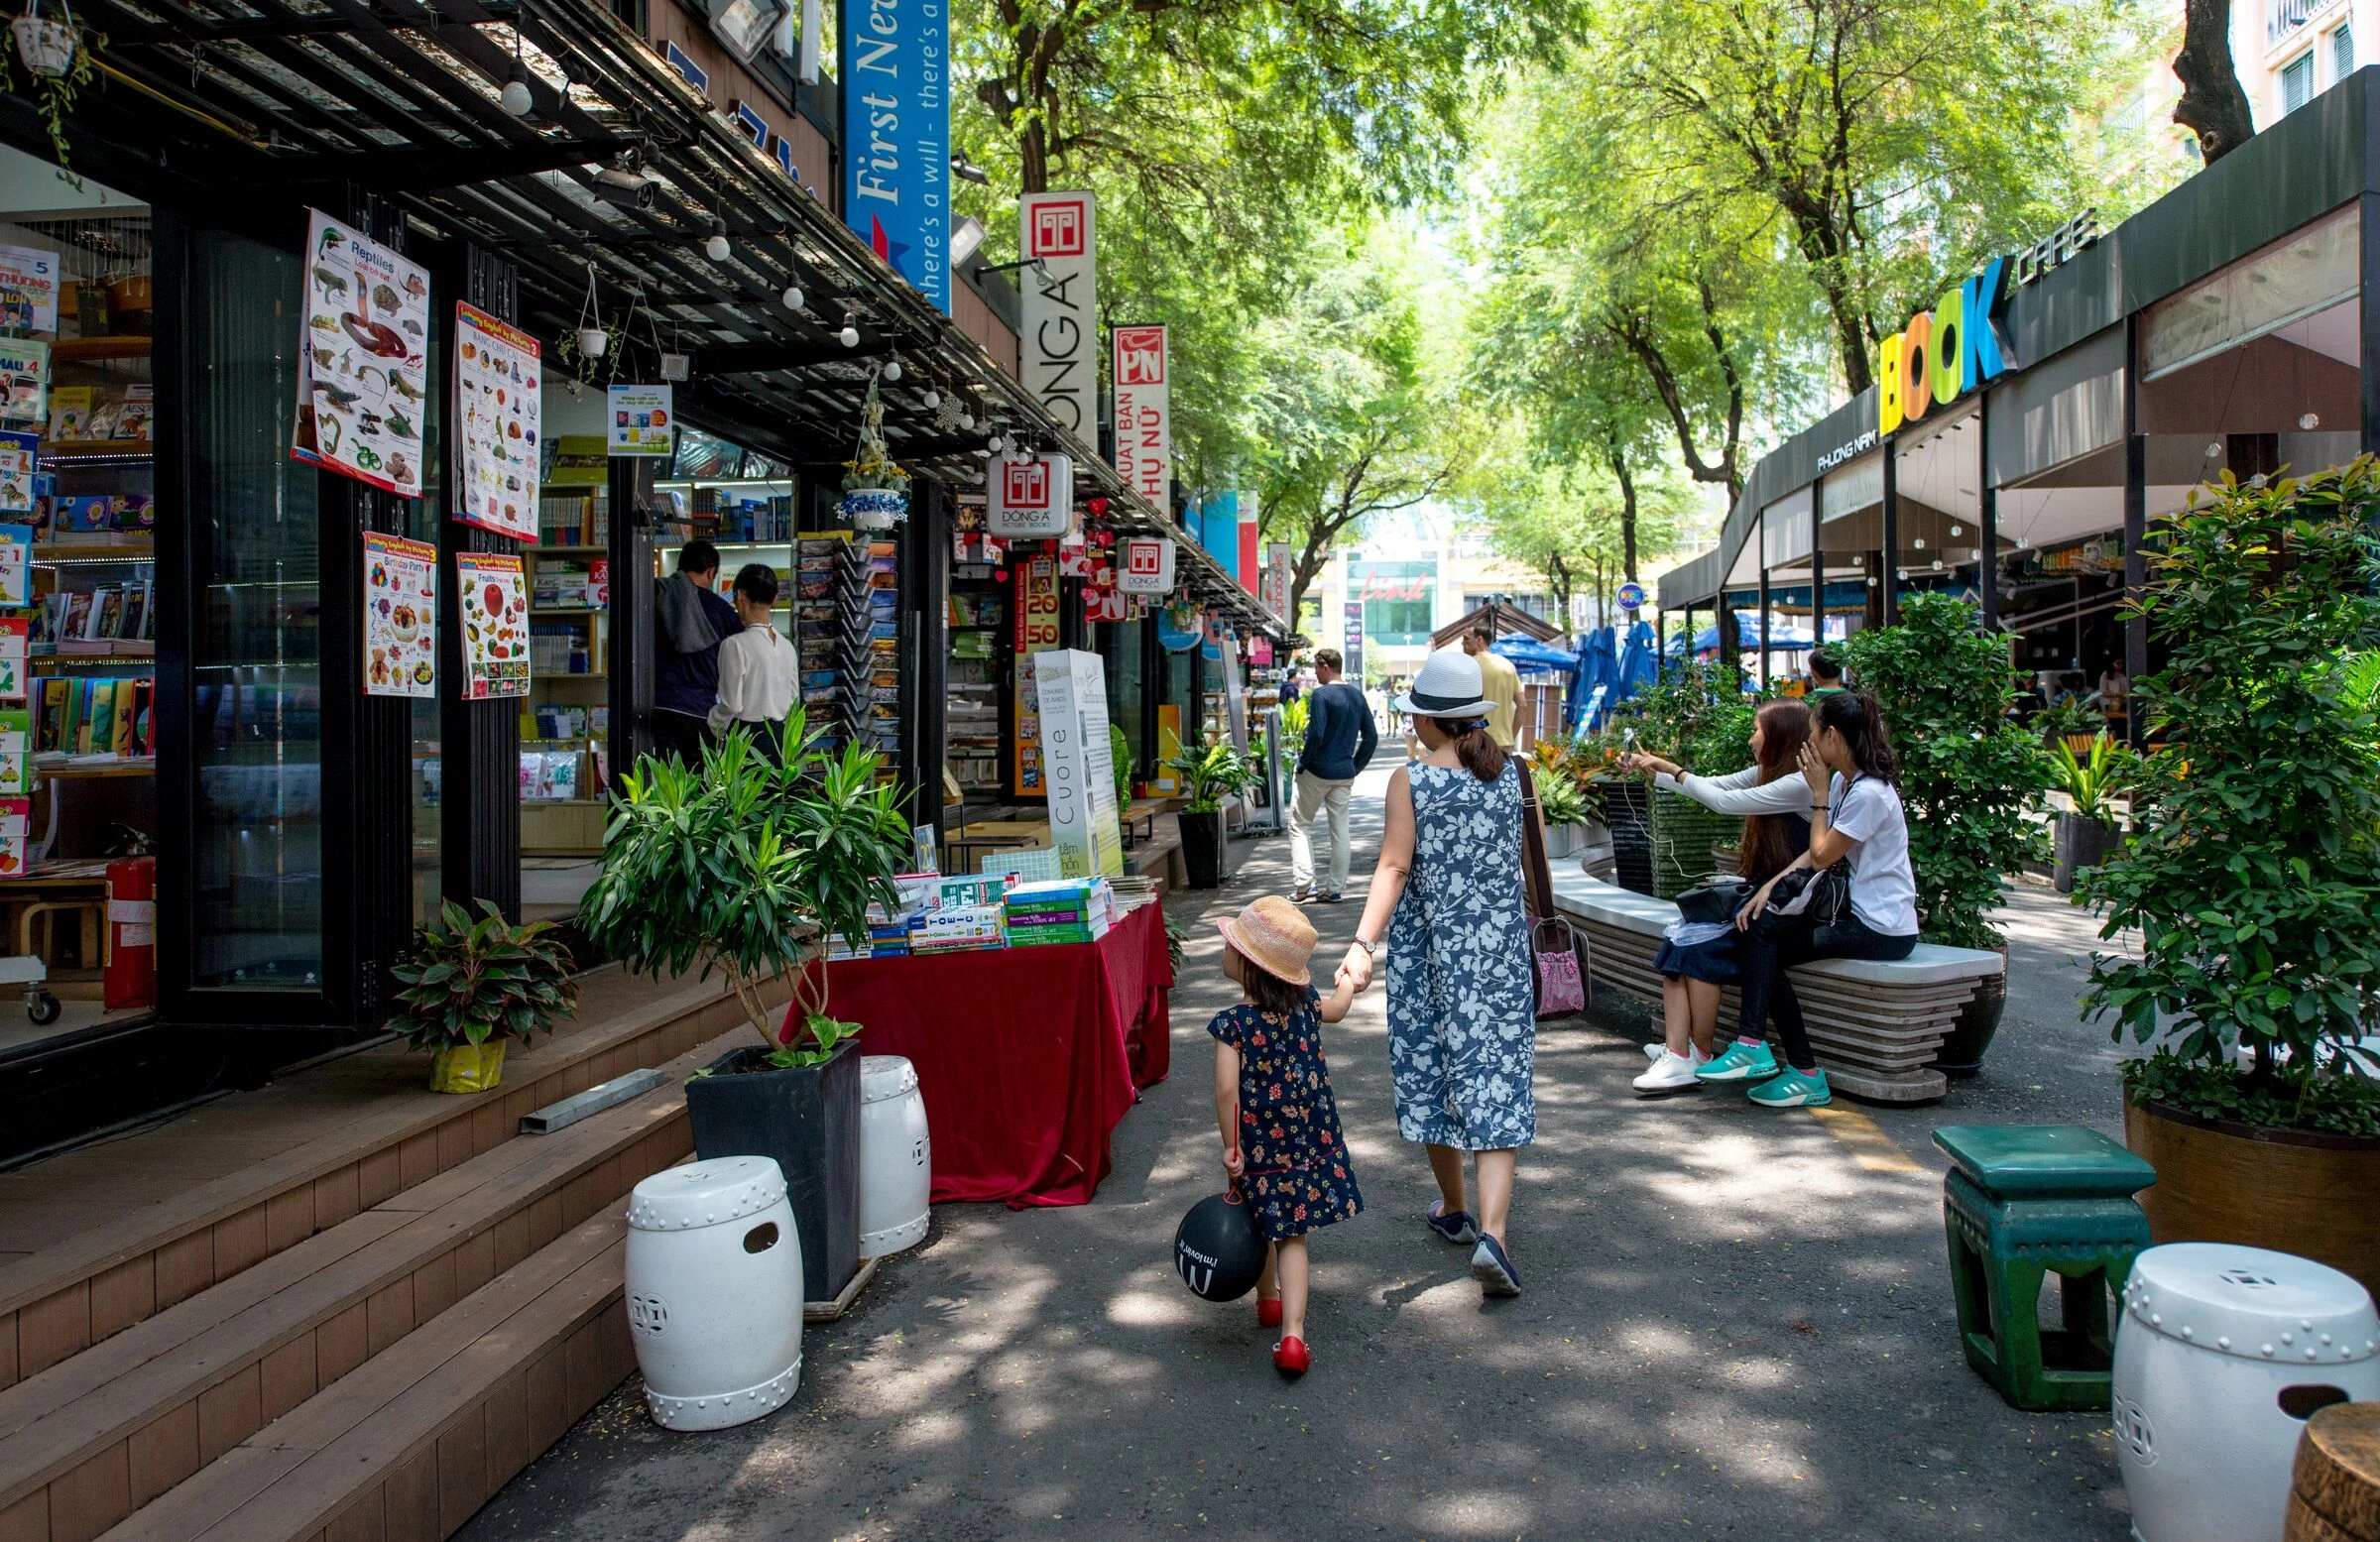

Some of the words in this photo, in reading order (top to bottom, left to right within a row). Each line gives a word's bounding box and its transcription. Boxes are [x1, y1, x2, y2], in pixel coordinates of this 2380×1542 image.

[923, 3, 938, 18] a
[917, 27, 938, 108] there's
[856, 92, 898, 206] First
[917, 140, 938, 182] will
[923, 193, 939, 207] a
[2017, 207, 2098, 287] CAFE
[351, 241, 395, 274] Reptiles
[35, 261, 49, 274] 5
[531, 343, 536, 356] 3
[1879, 255, 2019, 437] BOOK
[27, 361, 39, 374] 4
[1854, 428, 1877, 453] NAM
[1141, 458, 1166, 506] HỤ
[385, 556, 408, 569] Birthday
[409, 561, 424, 572] Party
[429, 548, 436, 563] 3
[478, 573, 496, 583] Fruits
[1359, 570, 1427, 602] Link
[1053, 729, 1074, 825] Cuore
[1059, 843, 1079, 855] tâm
[929, 915, 974, 925] TOEIC
[1183, 1245, 1204, 1264] lovin'
[1203, 1254, 1218, 1268] i'm
